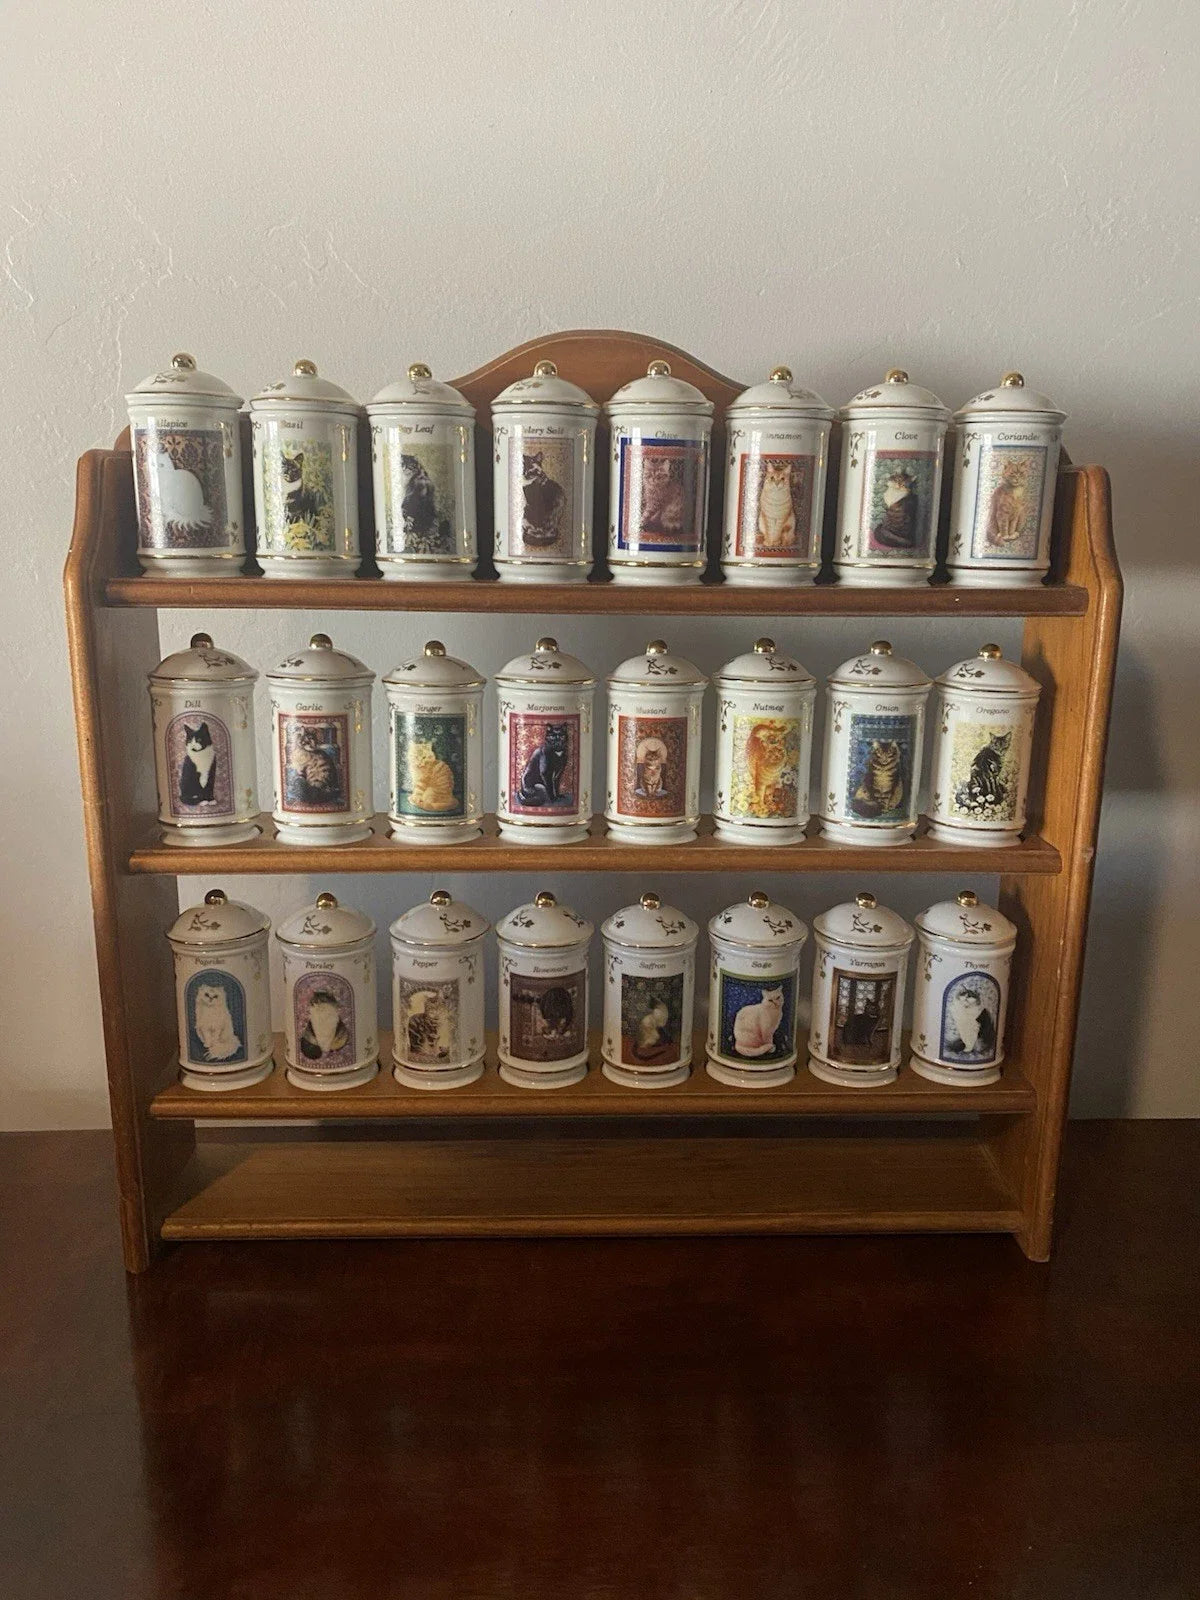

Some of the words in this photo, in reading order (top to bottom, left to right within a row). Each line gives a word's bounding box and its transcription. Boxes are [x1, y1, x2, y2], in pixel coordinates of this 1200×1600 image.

[414, 424, 433, 435] Leaf
[546, 426, 564, 436] Salt
[894, 431, 919, 441] Clove
[184, 699, 202, 709] Dill
[296, 702, 323, 712] Garlic
[526, 704, 565, 713] Marjoram
[753, 703, 784, 713] Nutmeg
[876, 703, 899, 713] Onion
[976, 705, 1010, 716] Oregano
[306, 960, 335, 971] Parsley
[412, 959, 438, 969] Pepper
[534, 964, 568, 974] Rosemary
[639, 961, 667, 971] Saffron
[752, 960, 772, 970] Sage
[850, 959, 886, 969] Tarragon
[964, 961, 990, 971] Thyme
